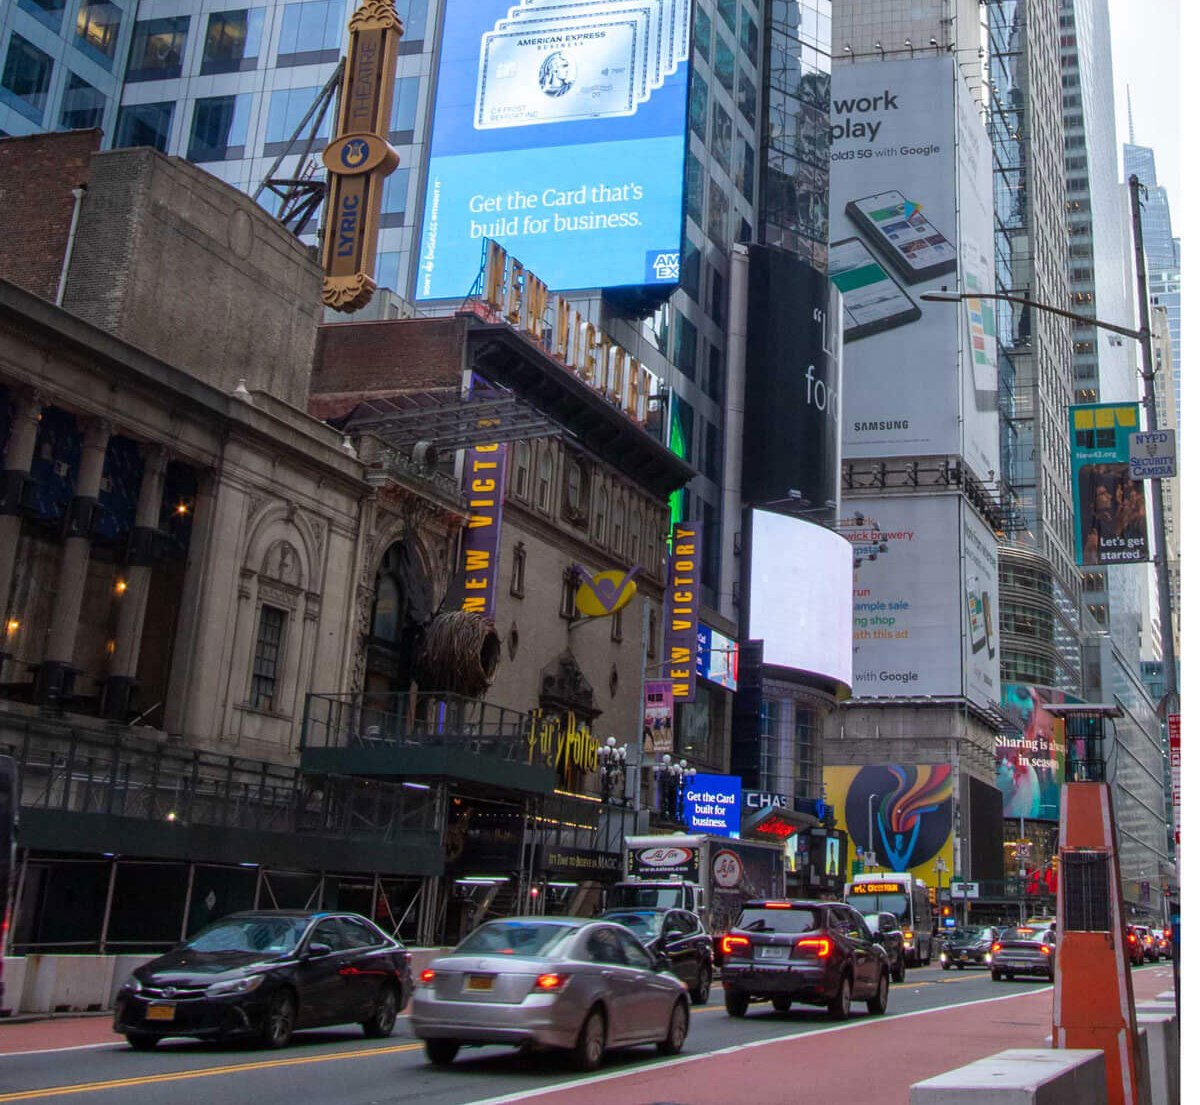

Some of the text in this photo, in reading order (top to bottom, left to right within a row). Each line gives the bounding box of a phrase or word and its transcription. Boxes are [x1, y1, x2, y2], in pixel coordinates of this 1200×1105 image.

[517, 31, 606, 47] AMERICAN EXPRESS
[354, 42, 378, 118] THEATRE
[833, 90, 899, 114] work
[829, 118, 882, 144] play
[857, 148, 872, 159] 5G
[874, 146, 898, 158] with
[900, 144, 940, 157] Google
[469, 182, 643, 213] Get the Card that's
[337, 195, 358, 258] LYRIC
[470, 211, 643, 239] build for business.
[653, 254, 680, 268] AM
[656, 267, 680, 279] EX
[854, 420, 909, 432] SAMSUNG
[1136, 433, 1168, 445] NYPD
[1130, 456, 1175, 467] SECURITY
[1133, 466, 1173, 476] CAMERA
[870, 530, 915, 542] brwery
[1100, 537, 1144, 550] Let's get
[463, 549, 490, 612] NEW
[888, 599, 909, 610] sale
[670, 528, 696, 697] NEW VICTORY
[870, 616, 896, 627] shop
[873, 629, 893, 639] this
[895, 629, 909, 639] ad
[855, 671, 919, 683] with Google
[995, 734, 1048, 753] Sharing is
[1018, 753, 1029, 766] in
[687, 791, 735, 804] Get the Card
[747, 793, 790, 809] CHAS
[695, 804, 726, 815] built for
[692, 817, 727, 828] business.
